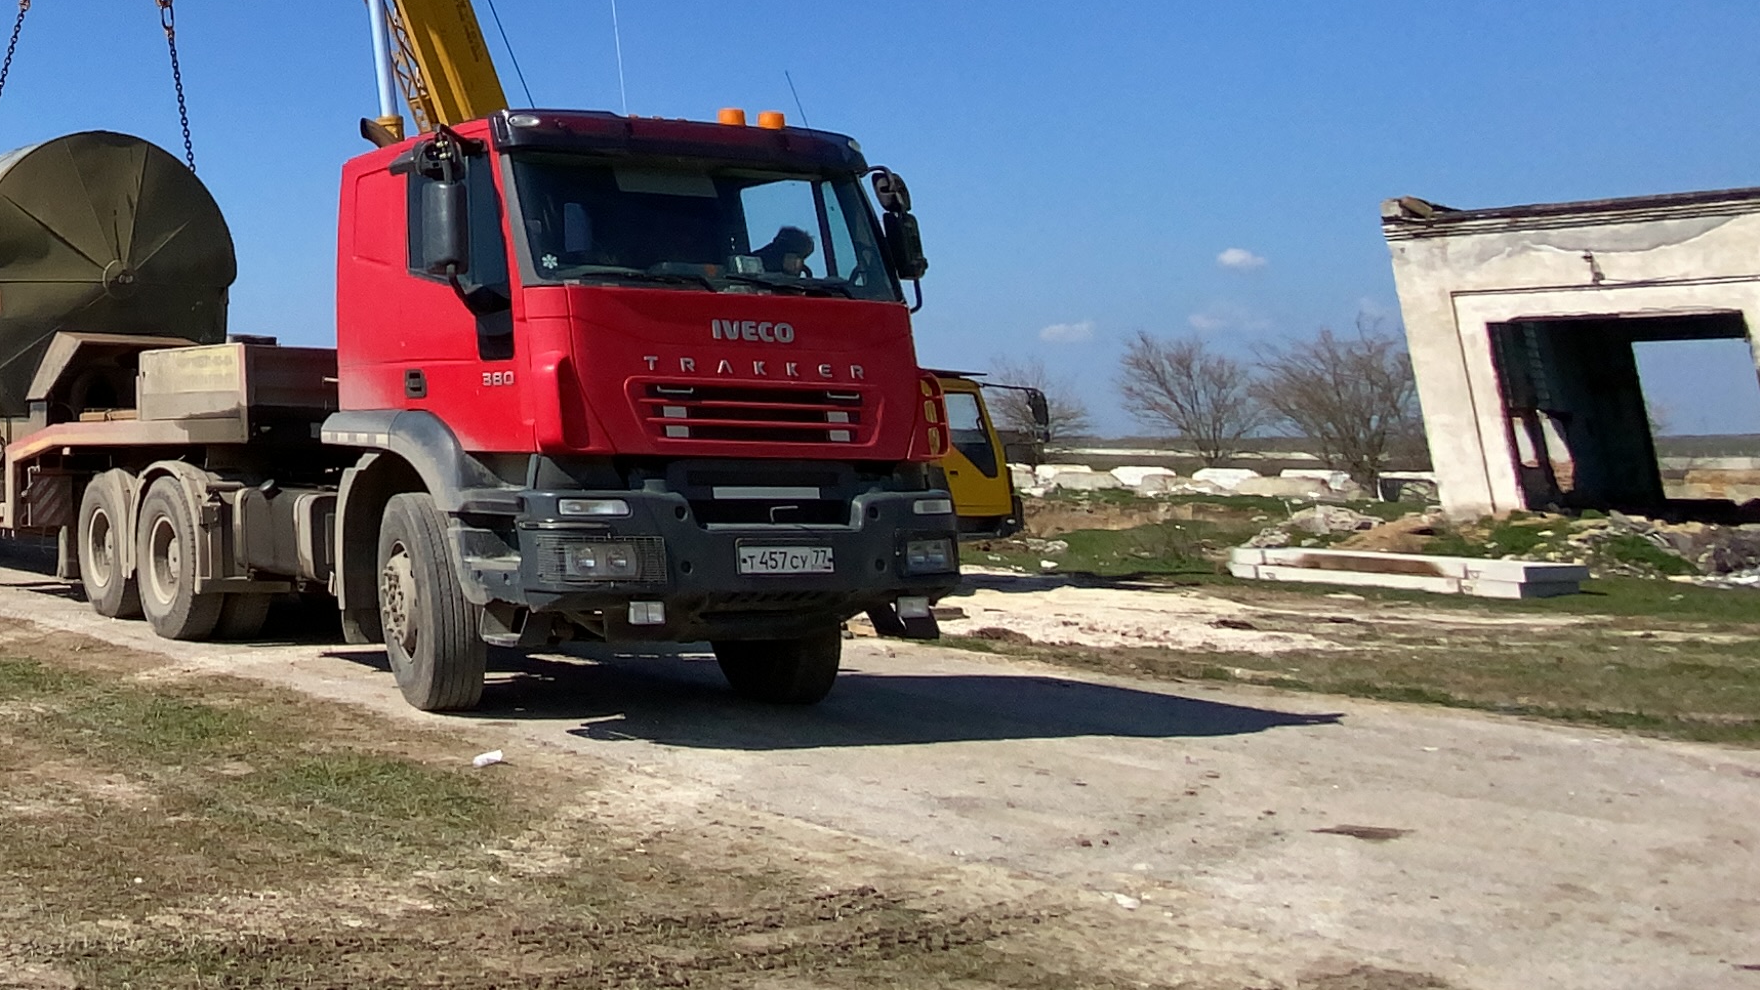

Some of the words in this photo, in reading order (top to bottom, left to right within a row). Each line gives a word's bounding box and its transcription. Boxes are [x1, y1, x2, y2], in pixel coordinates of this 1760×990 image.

[711, 319, 794, 343] IVECO
[643, 356, 864, 380] TRAKKER
[482, 371, 514, 386] 380
[813, 550, 827, 564] 77
